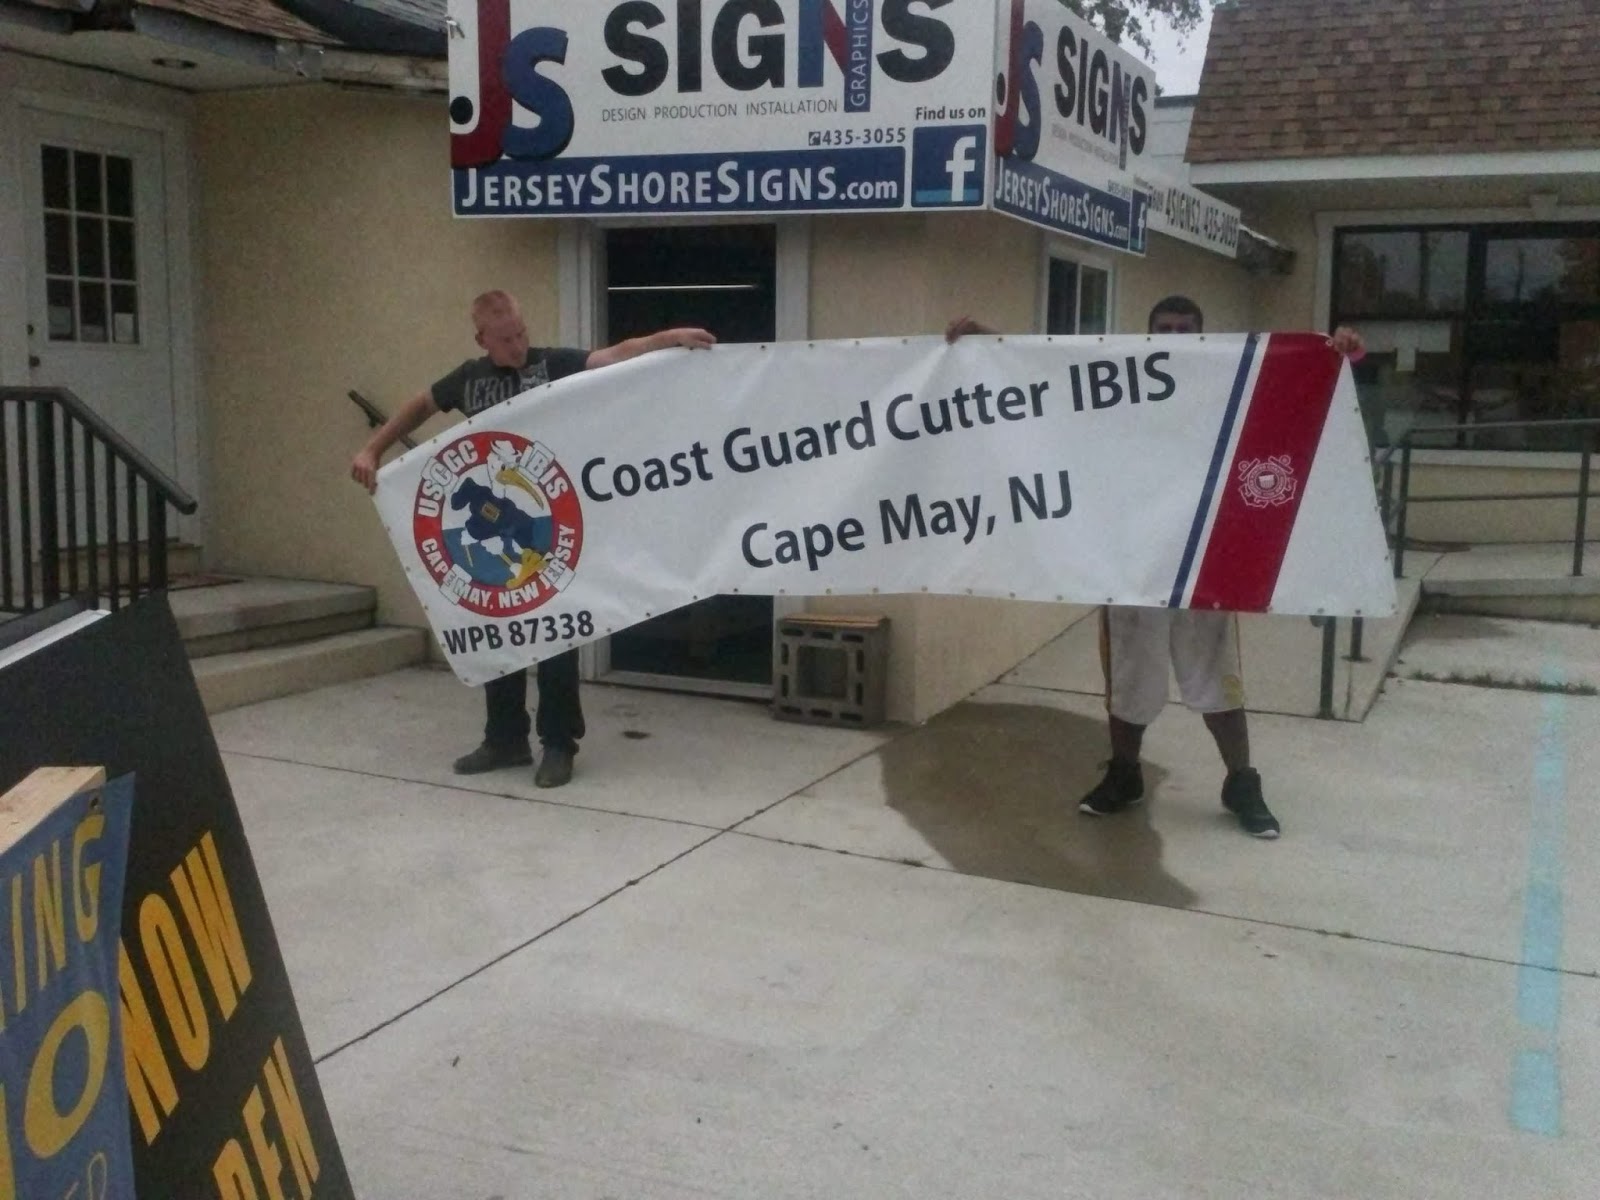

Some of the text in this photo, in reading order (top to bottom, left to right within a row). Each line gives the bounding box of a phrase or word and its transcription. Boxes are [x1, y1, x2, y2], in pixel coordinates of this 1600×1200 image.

[601, 0, 955, 97] SIGNS
[850, 0, 869, 107] GRAPHICS
[1054, 26, 1147, 160] SIGNS
[602, 99, 838, 122] DESIGN PRODUCTION INSTALLATION
[821, 127, 906, 146] 435-3055
[915, 106, 986, 121] Find us on
[581, 351, 1176, 502] Coast Guard Cutter IBIS
[418, 440, 568, 517] USCGC IBIS
[741, 470, 1074, 572] Cape May, NJ
[421, 538, 456, 587] CAPE
[499, 582, 540, 609] NEW
[539, 524, 576, 590] JERSEY
[443, 610, 595, 655] WPB 87338
[0, 814, 106, 1033] ING
